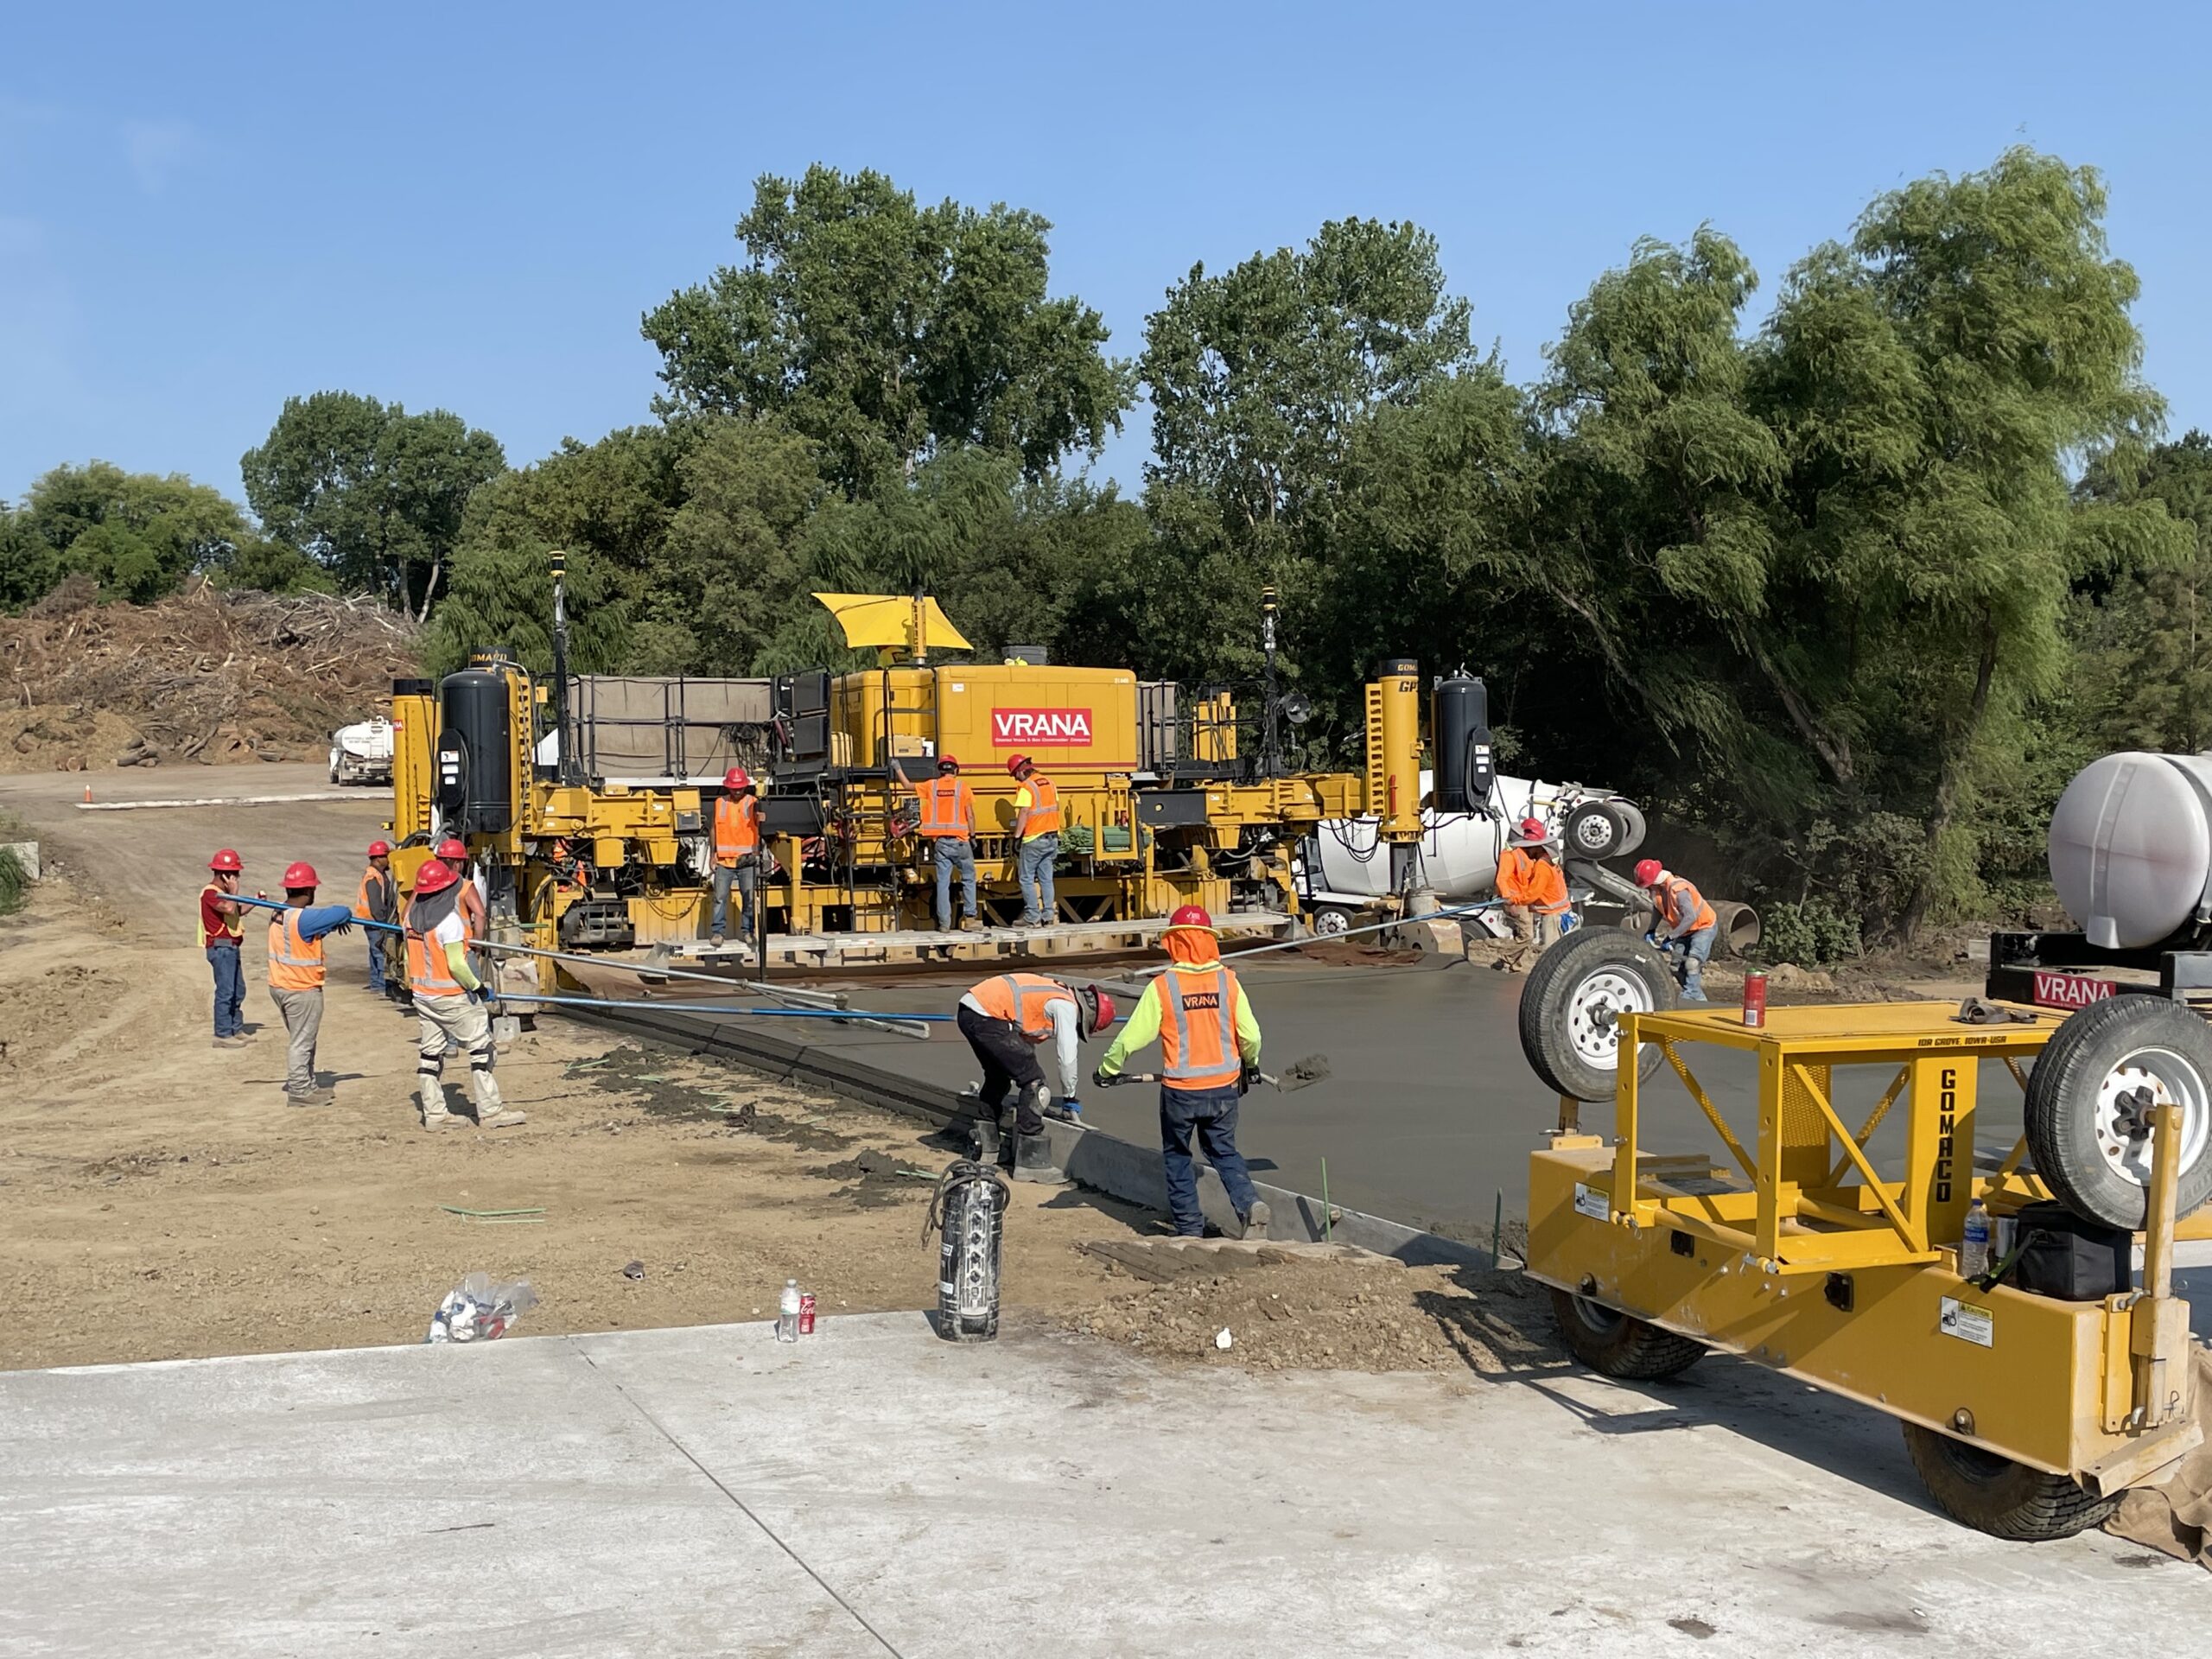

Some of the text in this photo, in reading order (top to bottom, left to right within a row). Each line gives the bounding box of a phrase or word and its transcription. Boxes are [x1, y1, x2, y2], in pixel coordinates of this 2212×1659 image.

[1399, 681, 1418, 692] GP
[995, 714, 1090, 736] VRANA
[2037, 976, 2110, 1004] VRANA
[1184, 996, 1217, 1007] VRANA
[1936, 1069, 1955, 1202] GOMACO
